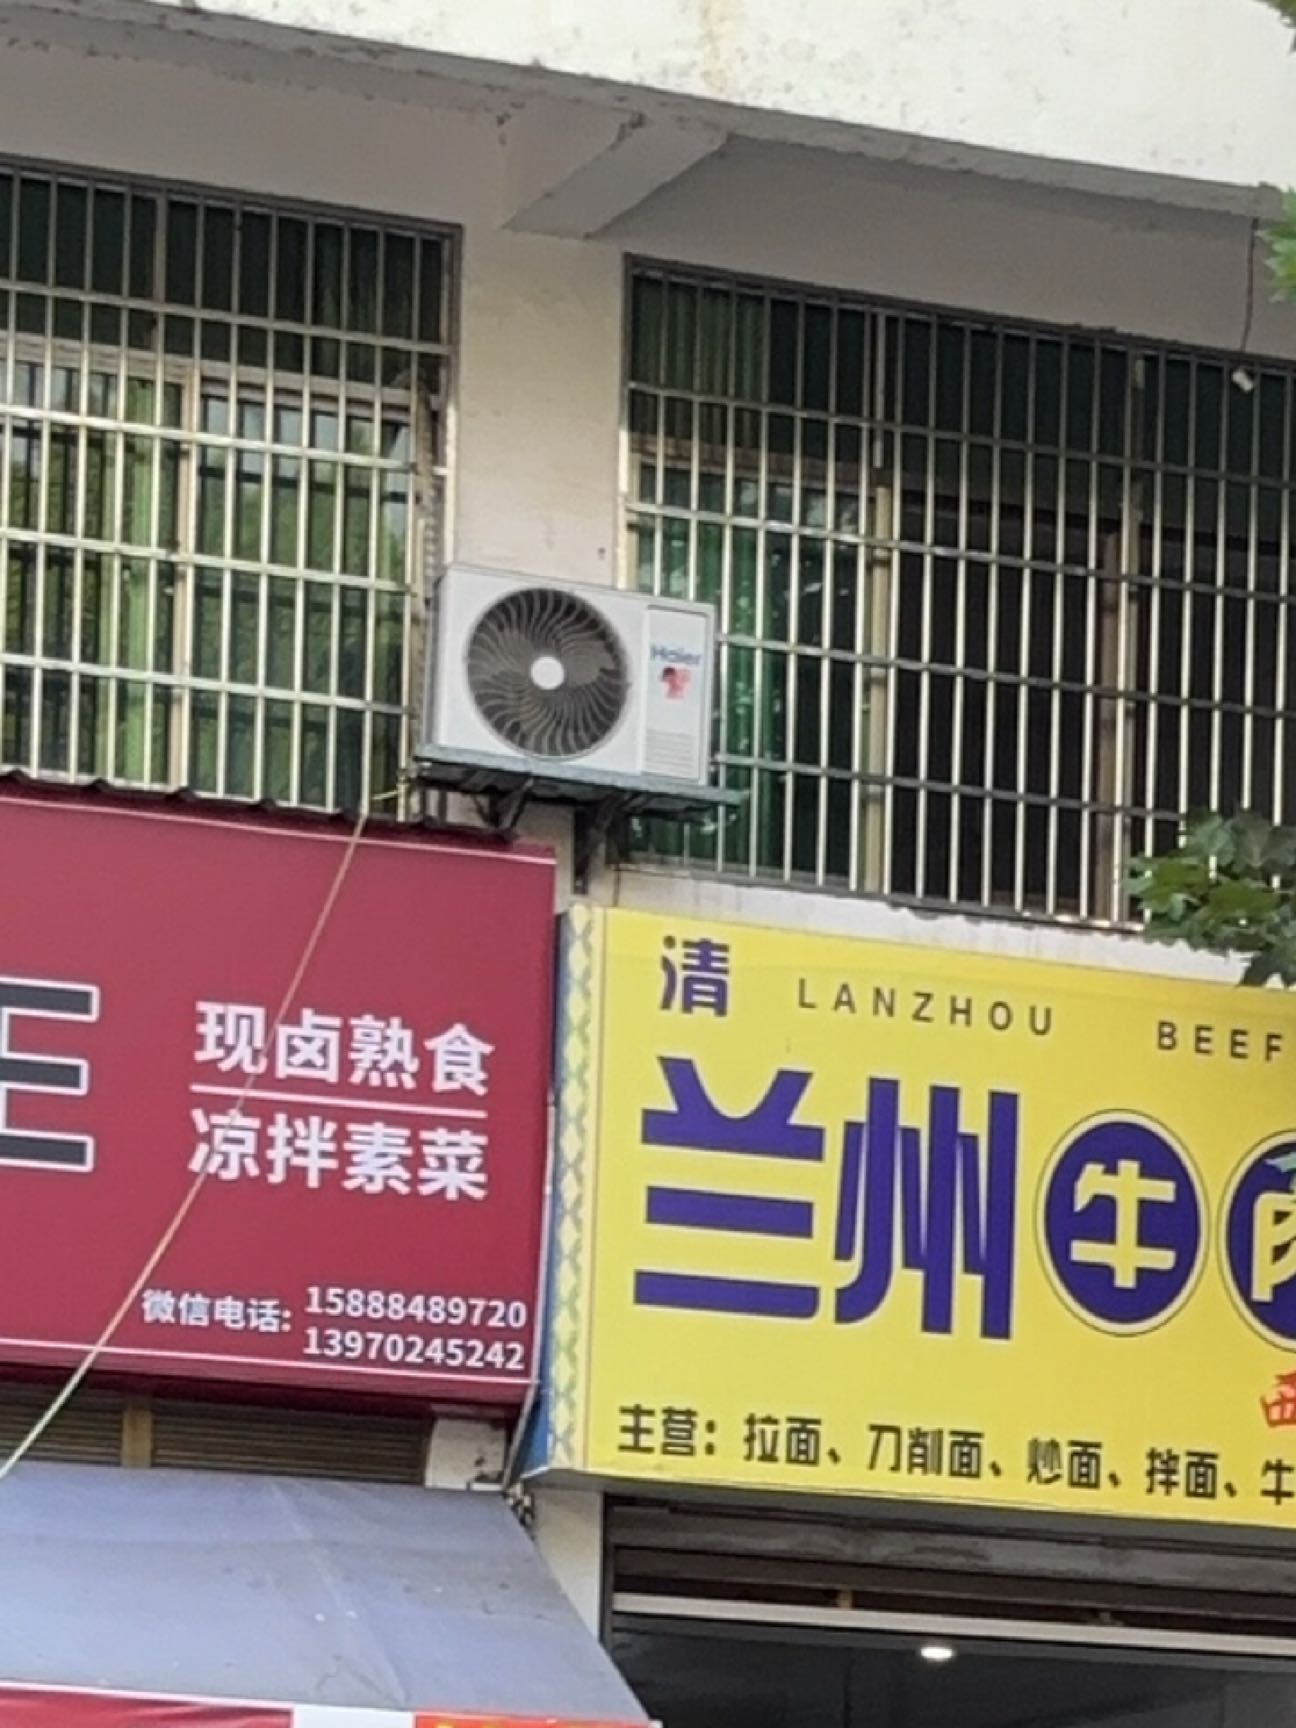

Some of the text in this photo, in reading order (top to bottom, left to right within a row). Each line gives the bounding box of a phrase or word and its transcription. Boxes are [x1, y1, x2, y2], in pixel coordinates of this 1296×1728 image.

[661, 936, 730, 1017] 清
[195, 1000, 496, 1096] 现卤熟食
[797, 978, 1053, 1036] LANZHOU
[1157, 1020, 1285, 1058] BEEF
[189, 1108, 489, 1201] 凉拌素菜
[305, 1286, 527, 1329] 15888489720
[303, 1329, 524, 1371] 13970245242
